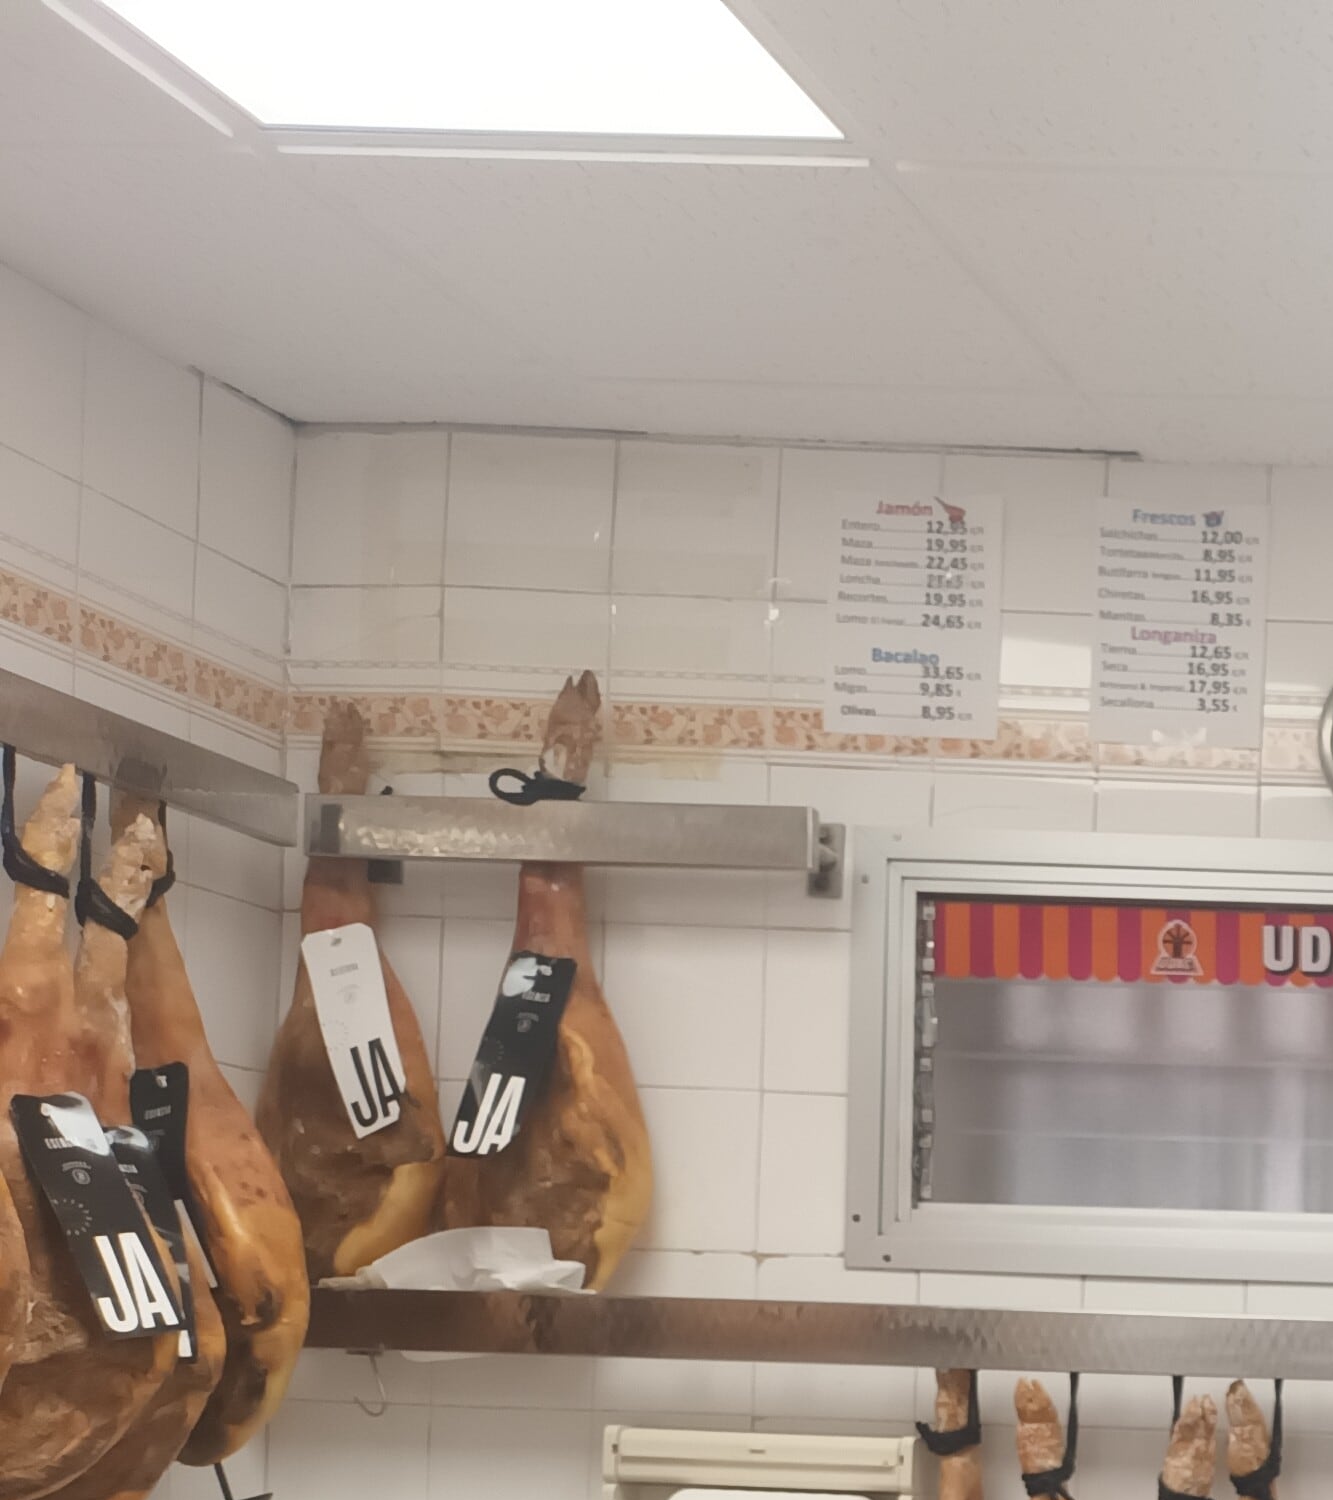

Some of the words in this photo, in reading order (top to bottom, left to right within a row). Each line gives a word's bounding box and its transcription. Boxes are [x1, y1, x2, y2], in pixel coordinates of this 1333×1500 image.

[876, 500, 933, 516] Jamón
[1132, 508, 1196, 526] Frescos
[926, 538, 967, 553] 19,95
[1201, 530, 1243, 546] 12,00
[926, 556, 968, 571] 22,45
[1203, 548, 1235, 563] 8,95
[1194, 568, 1236, 584] 11,95
[925, 592, 966, 608] 19,95
[1191, 590, 1233, 605] 16,95
[922, 613, 965, 630] 24,65
[1210, 612, 1243, 627] 8,35
[1131, 625, 1217, 645] Longaniza
[872, 648, 940, 665] Bacalao
[1190, 645, 1232, 660] 12,65
[1187, 662, 1229, 677] 16,95
[1188, 680, 1231, 695] 17,95
[921, 706, 955, 721] 8,95
[1197, 698, 1230, 713] 3,55
[350, 1037, 401, 1128] JA
[453, 1073, 526, 1155] JA
[94, 1231, 180, 1333] JA
